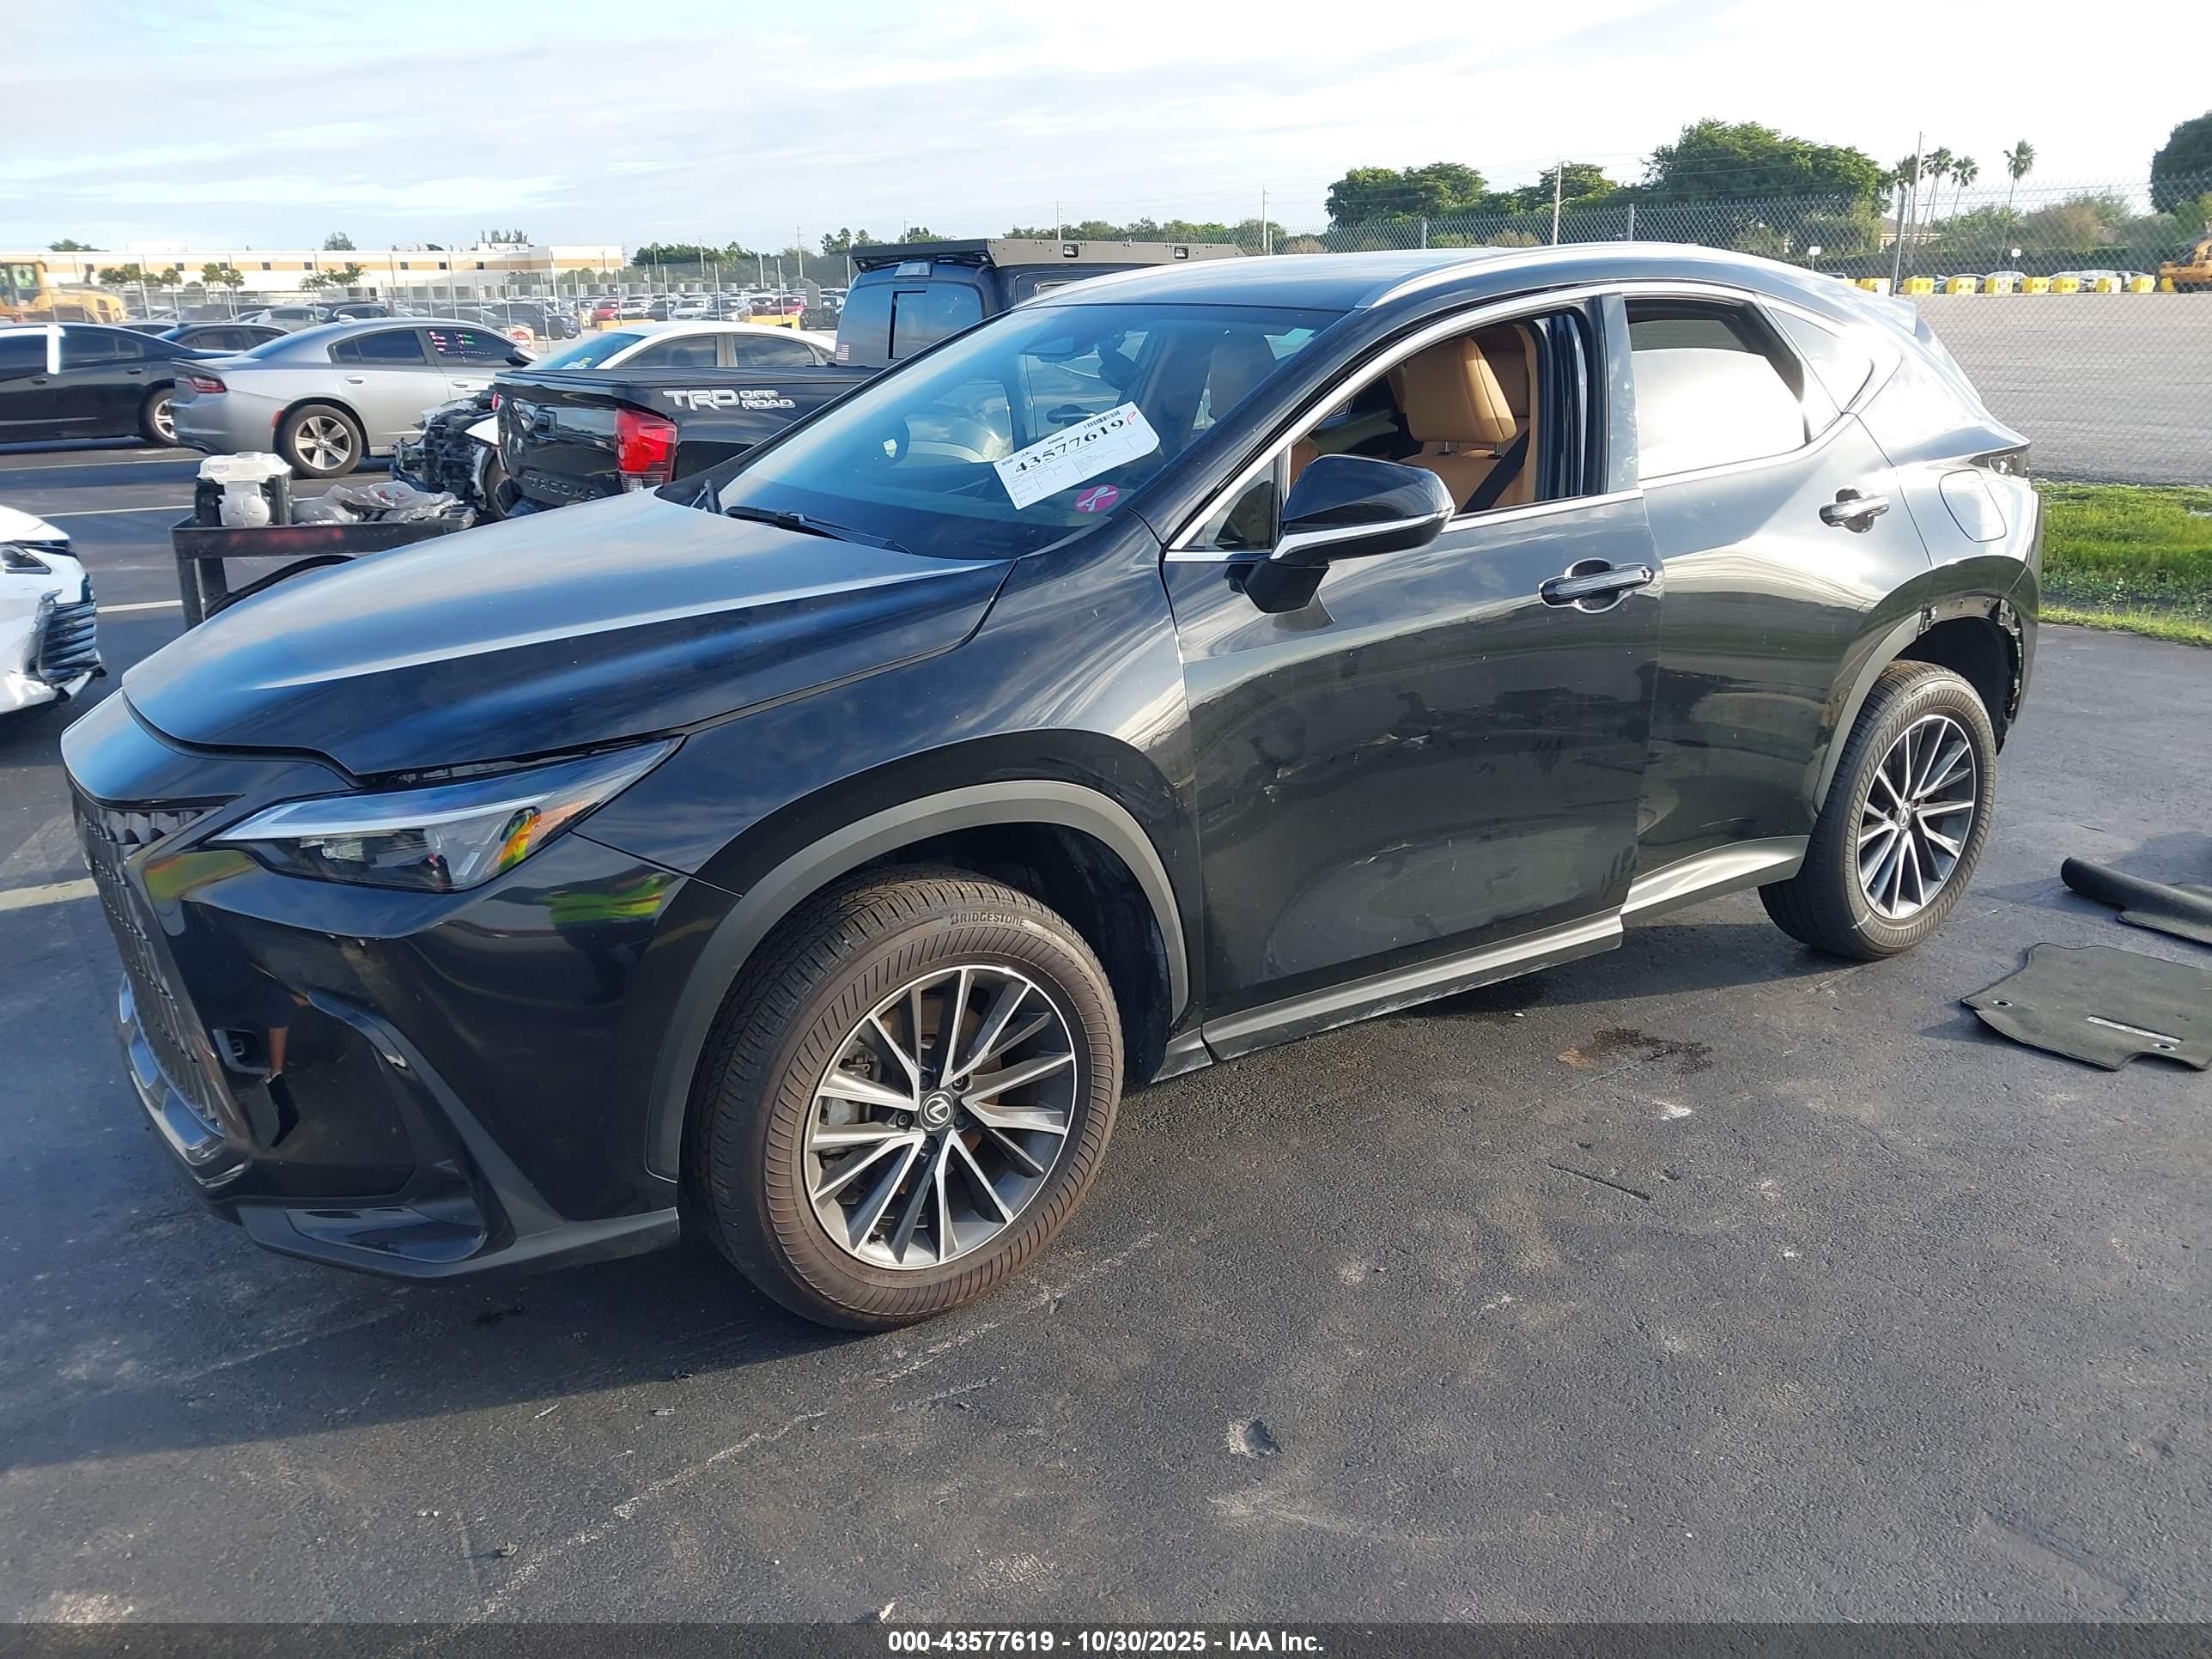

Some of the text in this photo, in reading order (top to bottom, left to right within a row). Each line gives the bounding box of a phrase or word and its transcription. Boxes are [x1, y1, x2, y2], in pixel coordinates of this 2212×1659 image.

[662, 389, 739, 411] TRD
[739, 390, 779, 400] OFF
[741, 399, 797, 410] ROAD
[1014, 419, 1125, 474] 43577619
[524, 476, 597, 500] TACOMA
[951, 912, 1026, 927] BRIDGESTONE
